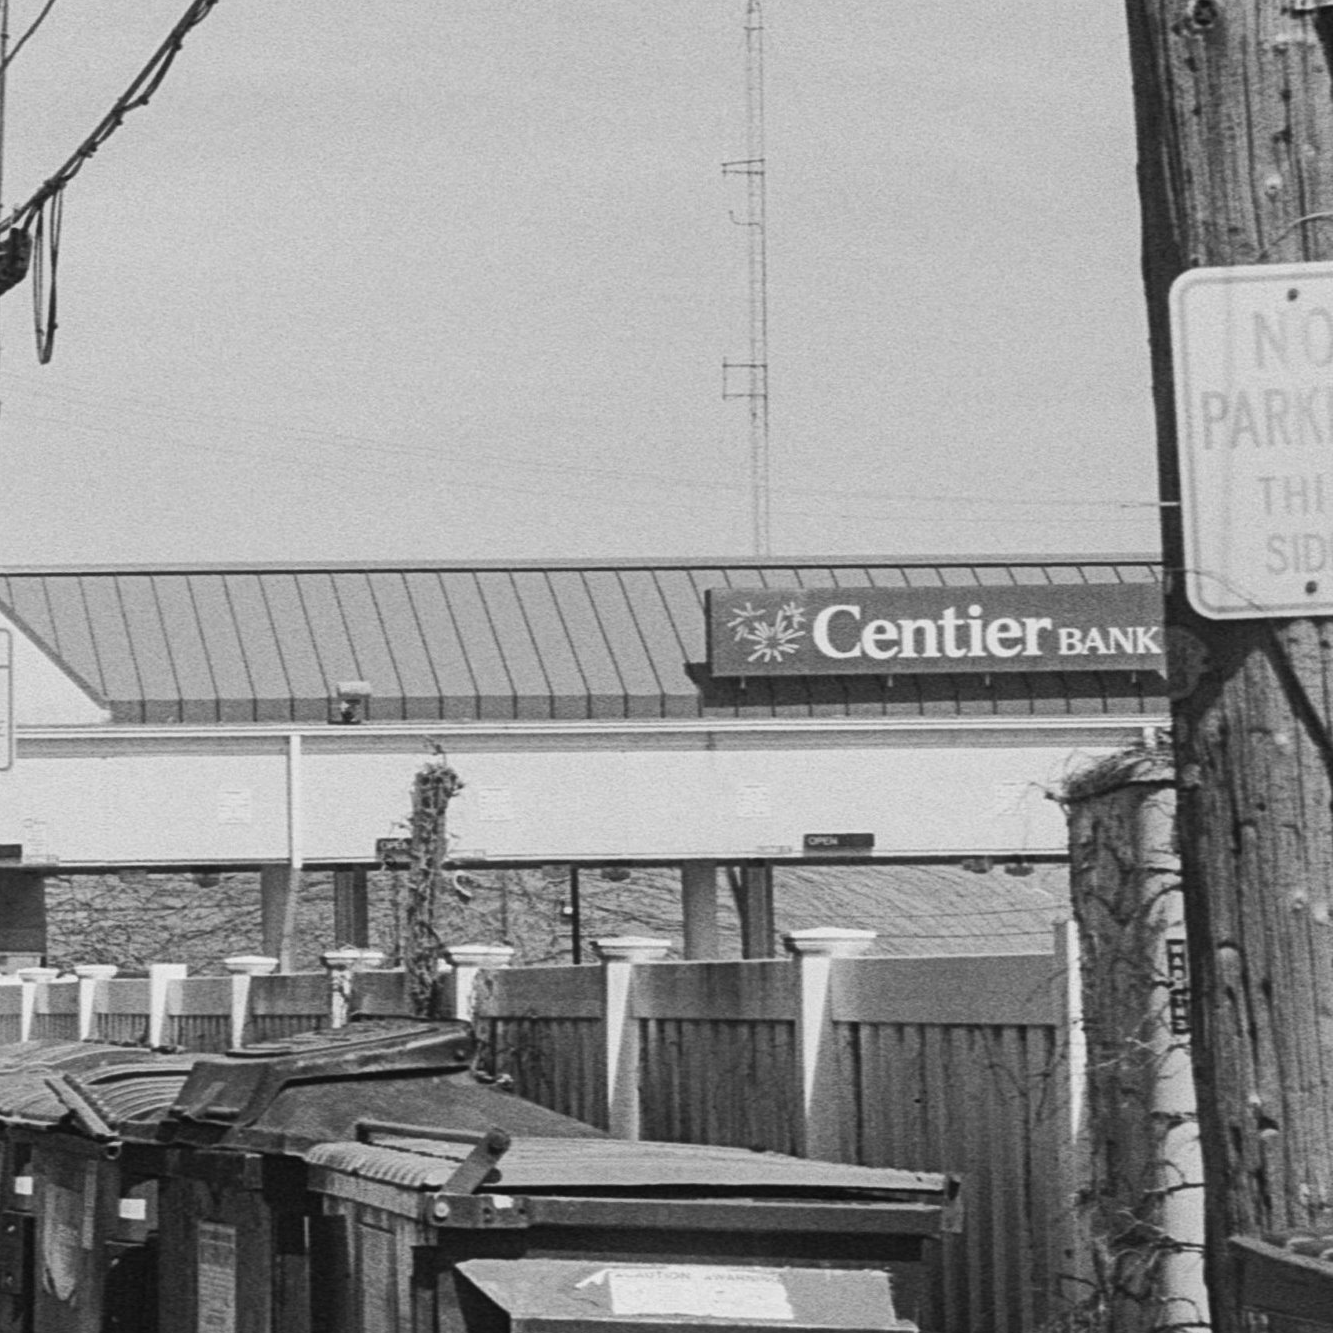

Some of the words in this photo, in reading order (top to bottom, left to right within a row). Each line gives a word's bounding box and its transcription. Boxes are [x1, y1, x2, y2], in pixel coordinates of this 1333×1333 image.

[1252, 307, 1333, 370] NO
[1265, 533, 1333, 576] SID
[813, 604, 1053, 660] Centier
[1058, 626, 1162, 656] BANK
